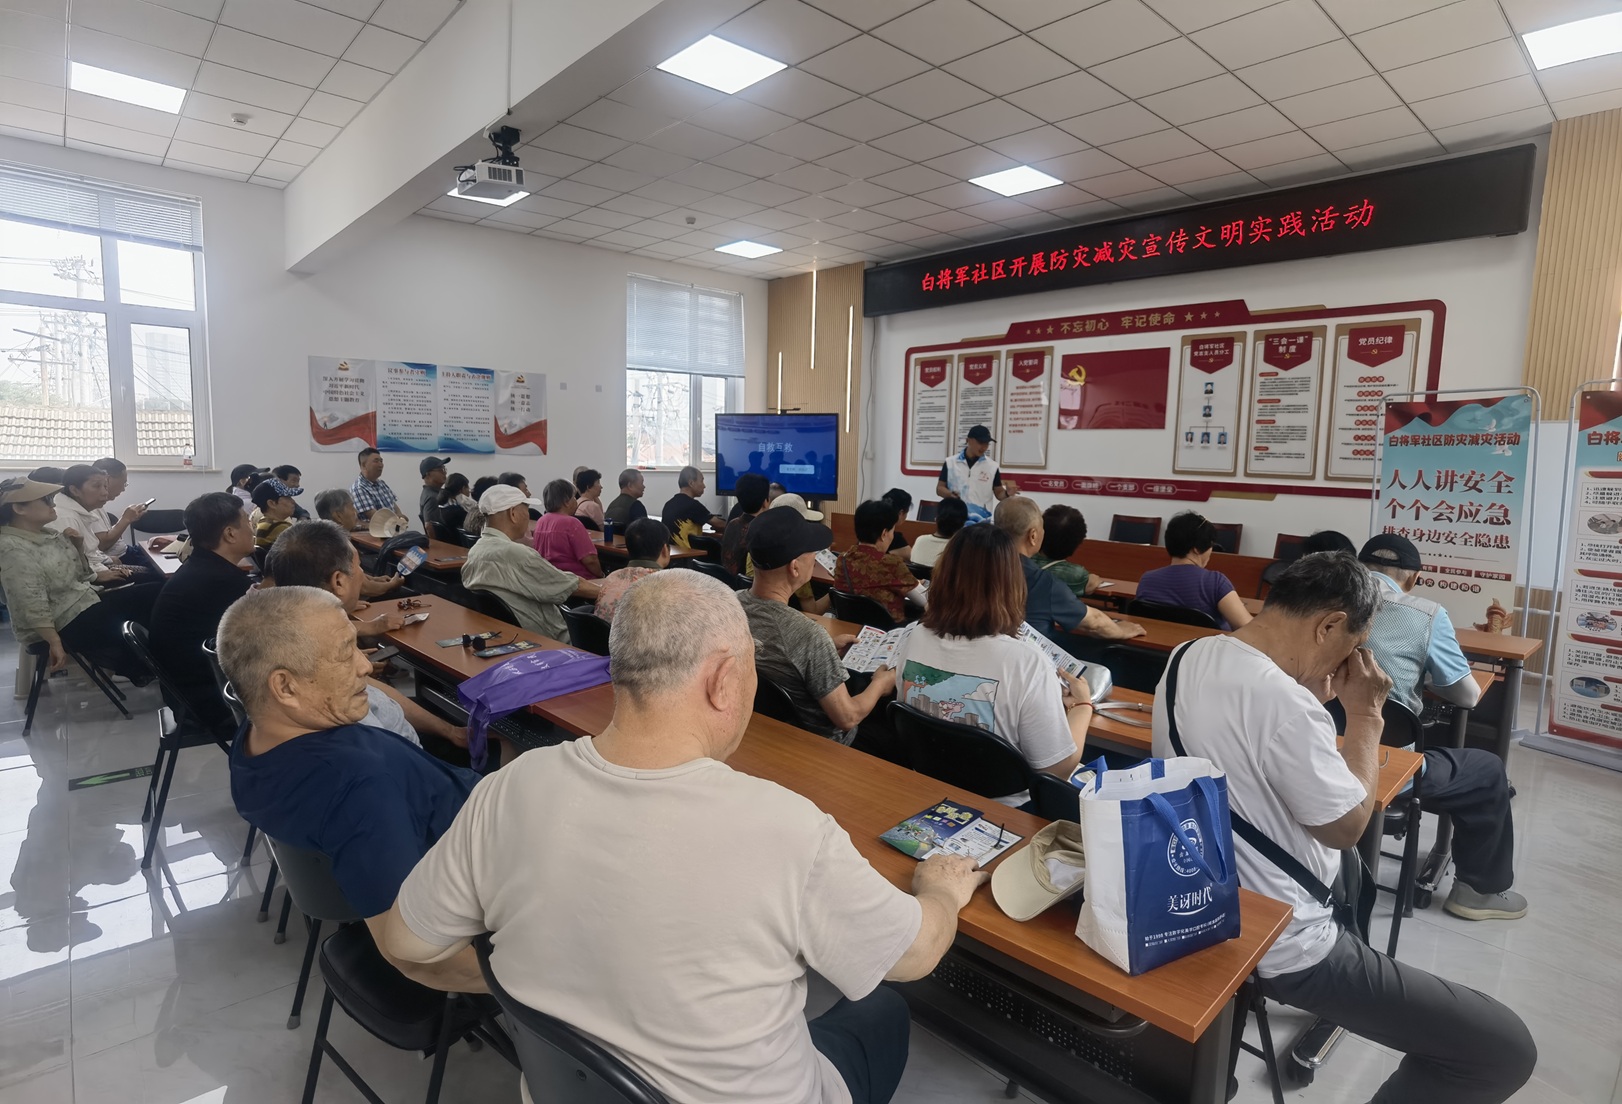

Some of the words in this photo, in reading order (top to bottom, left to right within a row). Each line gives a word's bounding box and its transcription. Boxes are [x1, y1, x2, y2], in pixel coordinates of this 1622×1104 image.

[920, 198, 1375, 292] 白将军社区开展防灾减灾宣传文明实践活动
[1060, 318, 1110, 335] 不忘初心
[1120, 311, 1176, 329] 牢记使命
[1358, 335, 1394, 346] 党员纪律
[758, 442, 793, 453] 自救互救
[1388, 432, 1521, 447] 白将军社区防灾减灾活动
[1587, 431, 1622, 446] 白将
[1386, 468, 1516, 494] 人人讲安全
[1384, 498, 1512, 526] 个个会应急
[1382, 525, 1511, 549] 排查身边安全隐患
[1439, 580, 1481, 593] 构建和谐
